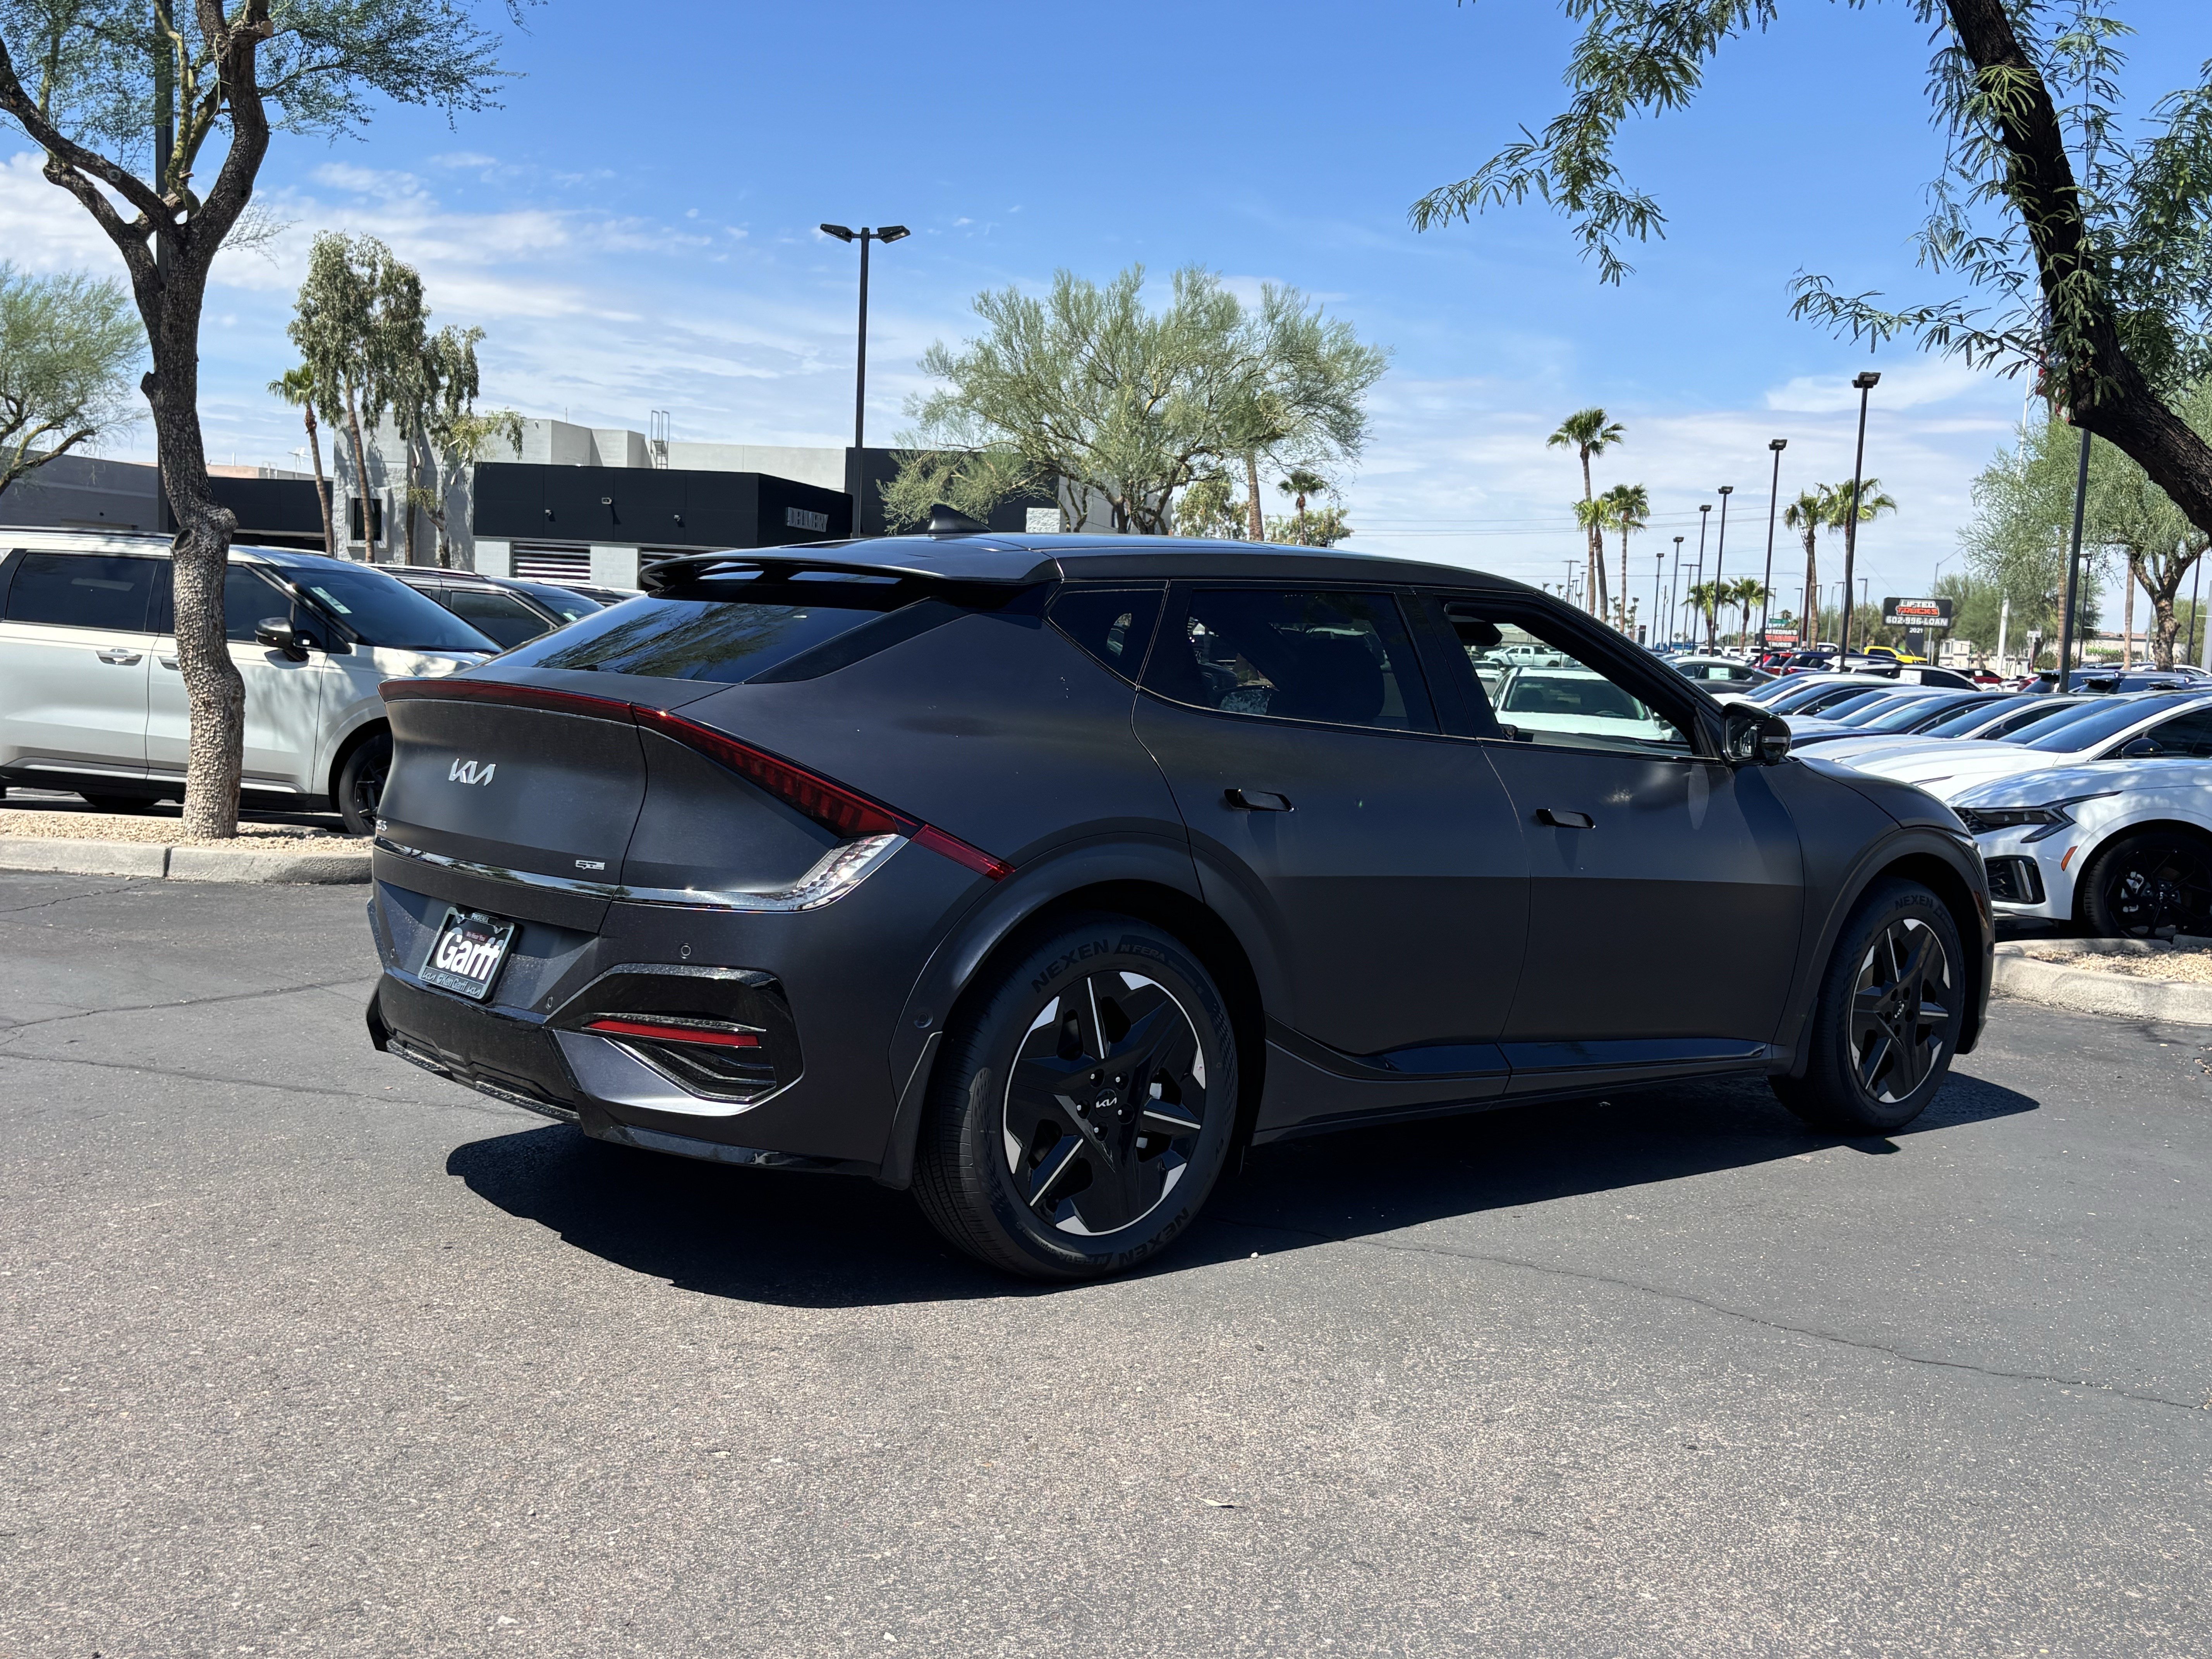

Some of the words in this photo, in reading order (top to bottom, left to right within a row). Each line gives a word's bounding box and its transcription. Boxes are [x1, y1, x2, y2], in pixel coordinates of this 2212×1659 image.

[787, 507, 828, 532] DELIVERY
[1898, 607, 1938, 615] TRUCKS
[1895, 895, 1933, 910] NEXEN
[436, 927, 504, 980] Garff
[1031, 939, 1109, 993] NEXEN
[1096, 1097, 1117, 1108] KIA
[1119, 1207, 1189, 1265] NEXEN
